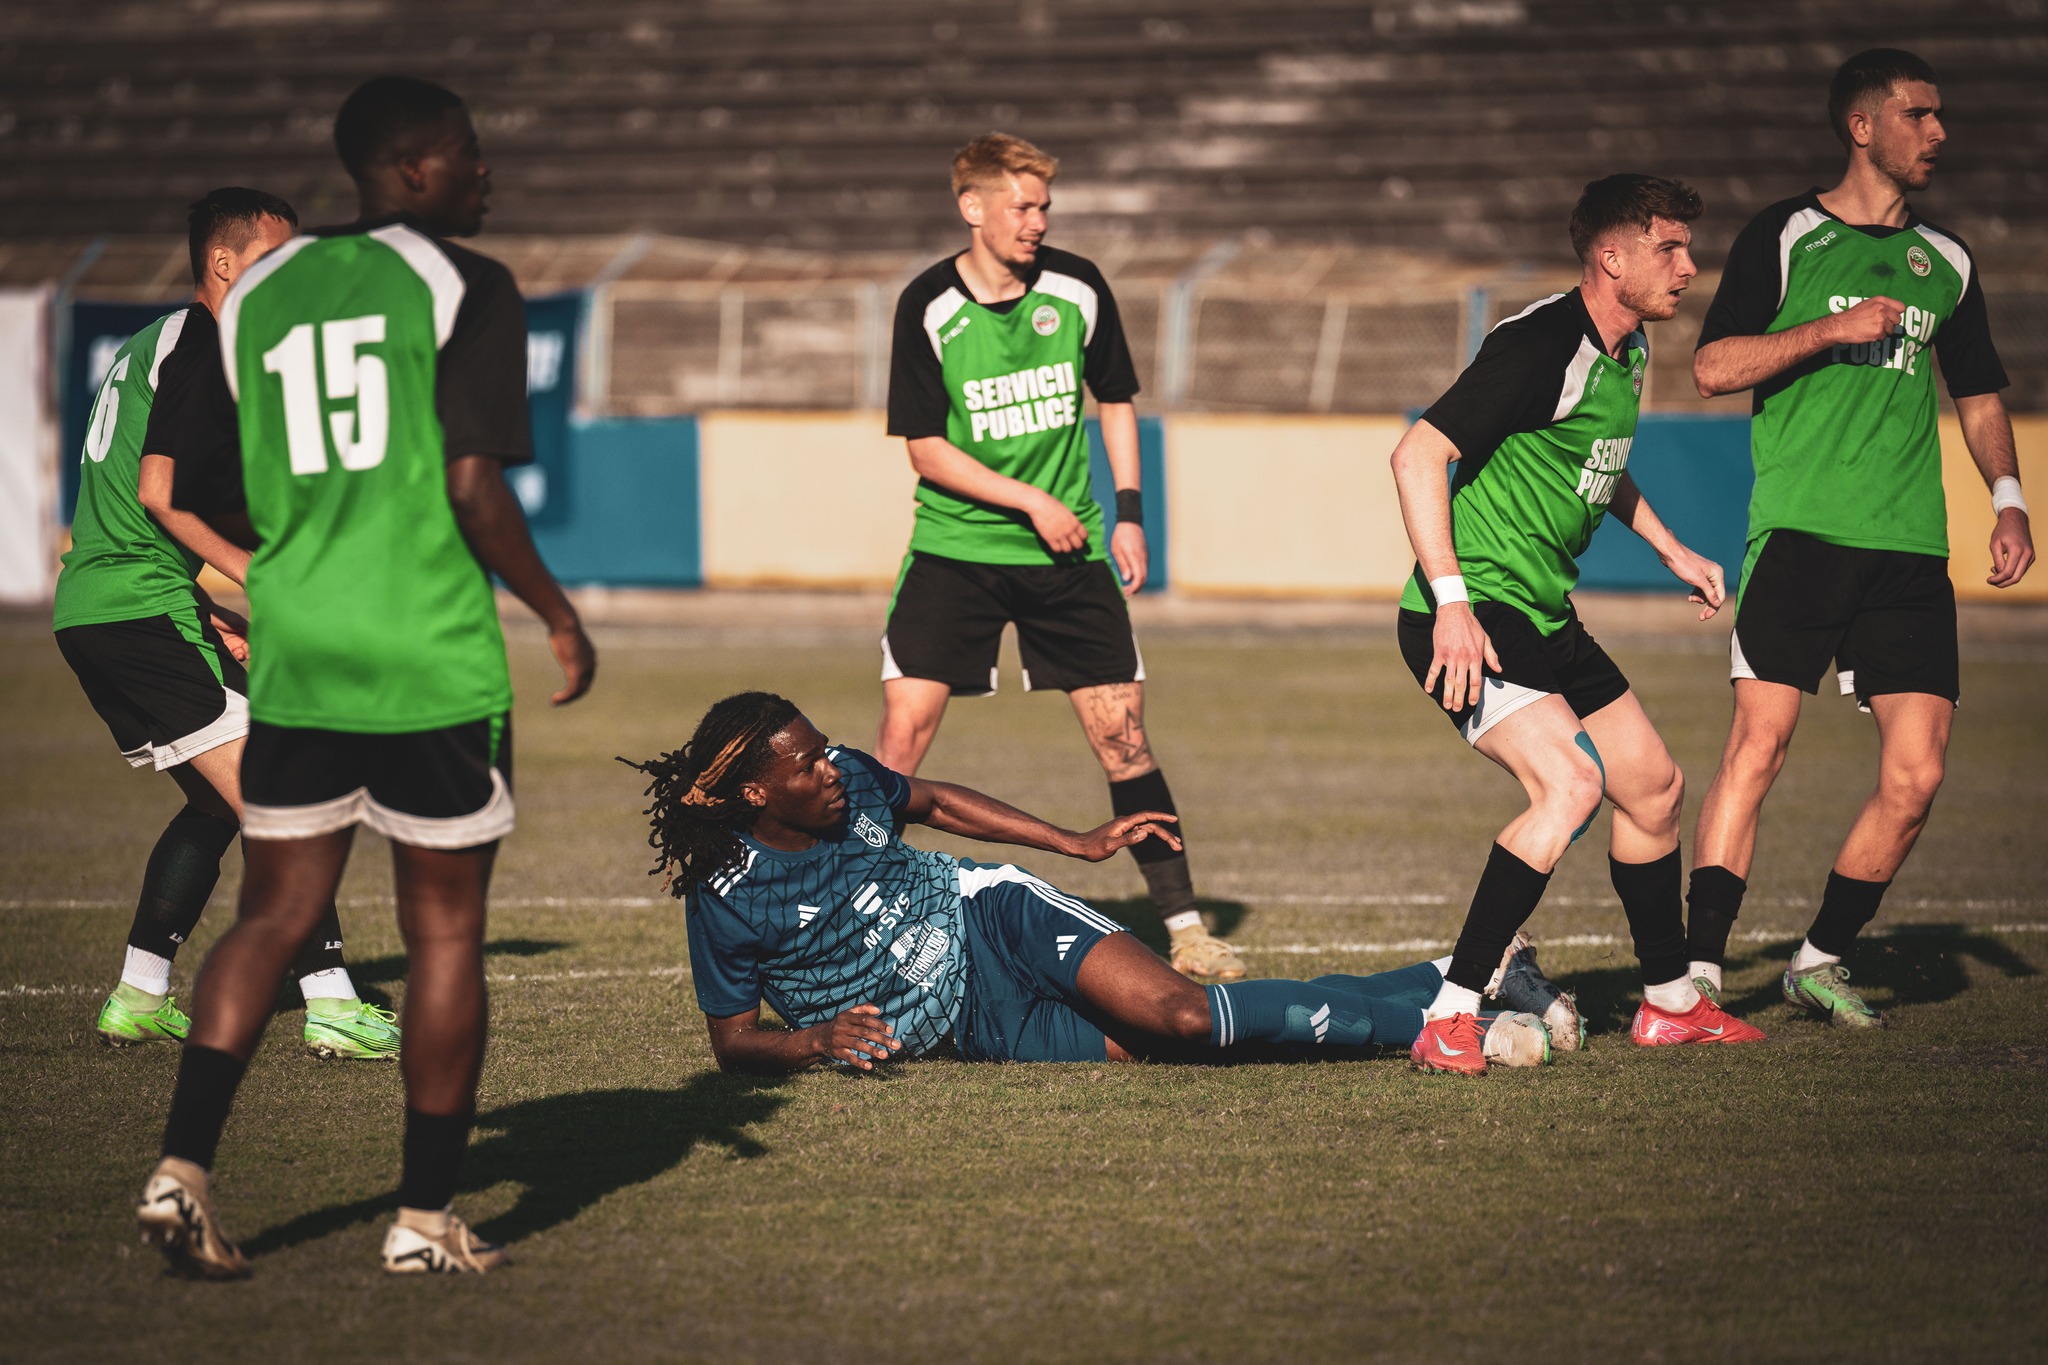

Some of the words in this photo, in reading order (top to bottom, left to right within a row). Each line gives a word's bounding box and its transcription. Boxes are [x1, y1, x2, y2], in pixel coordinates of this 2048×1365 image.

[262, 314, 390, 477] 15
[962, 361, 1077, 411] SERVICII
[970, 394, 1076, 442] PUBLICE
[325, 940, 343, 950] LE
[863, 893, 910, 950] M-SYS
[904, 927, 949, 984] TECHNOLOGY
